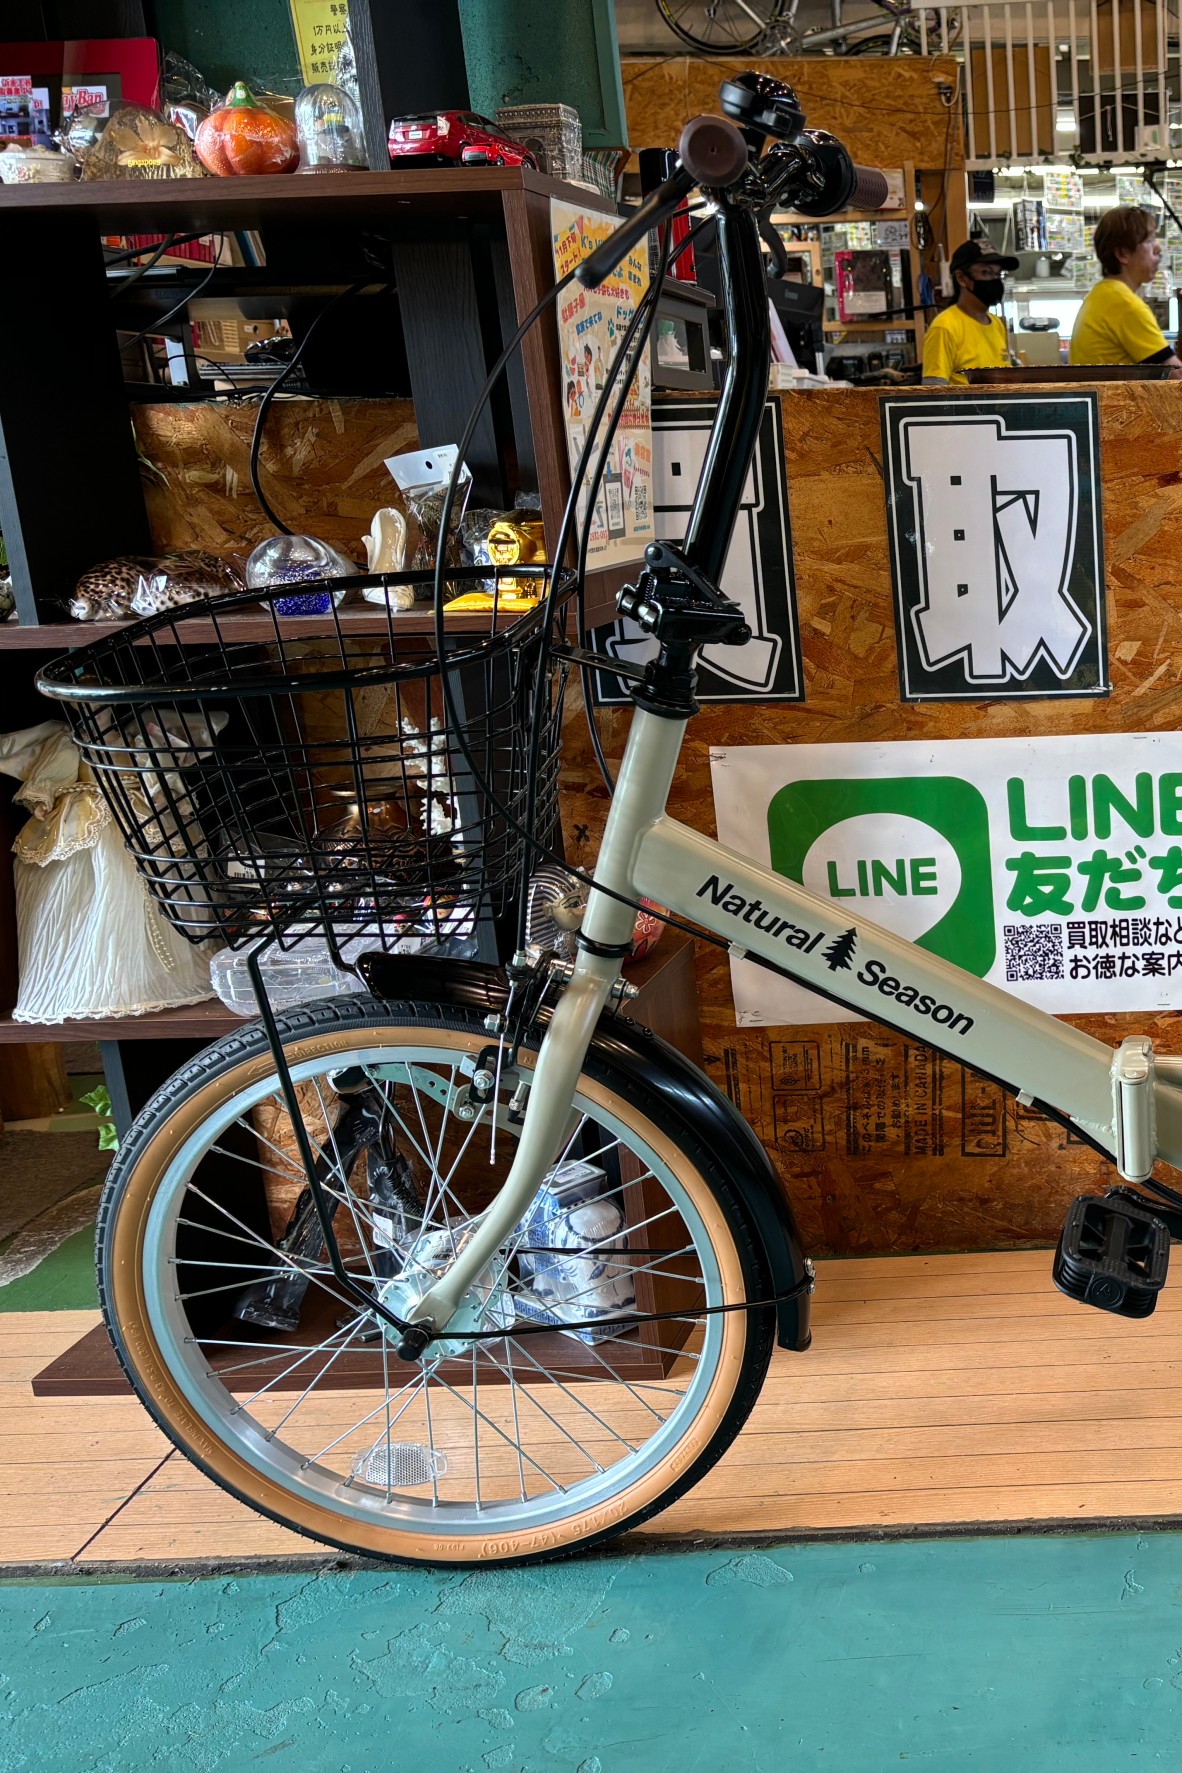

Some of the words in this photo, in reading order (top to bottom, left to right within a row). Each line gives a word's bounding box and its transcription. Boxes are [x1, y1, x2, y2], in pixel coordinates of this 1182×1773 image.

[827, 856, 938, 899] LINE
[697, 874, 820, 956] Natural
[856, 959, 976, 1038] Season
[295, 1039, 349, 1059] DIRECTION
[913, 1044, 928, 1099] CANADA
[913, 1102, 928, 1116] IN
[913, 1120, 928, 1156] MADE
